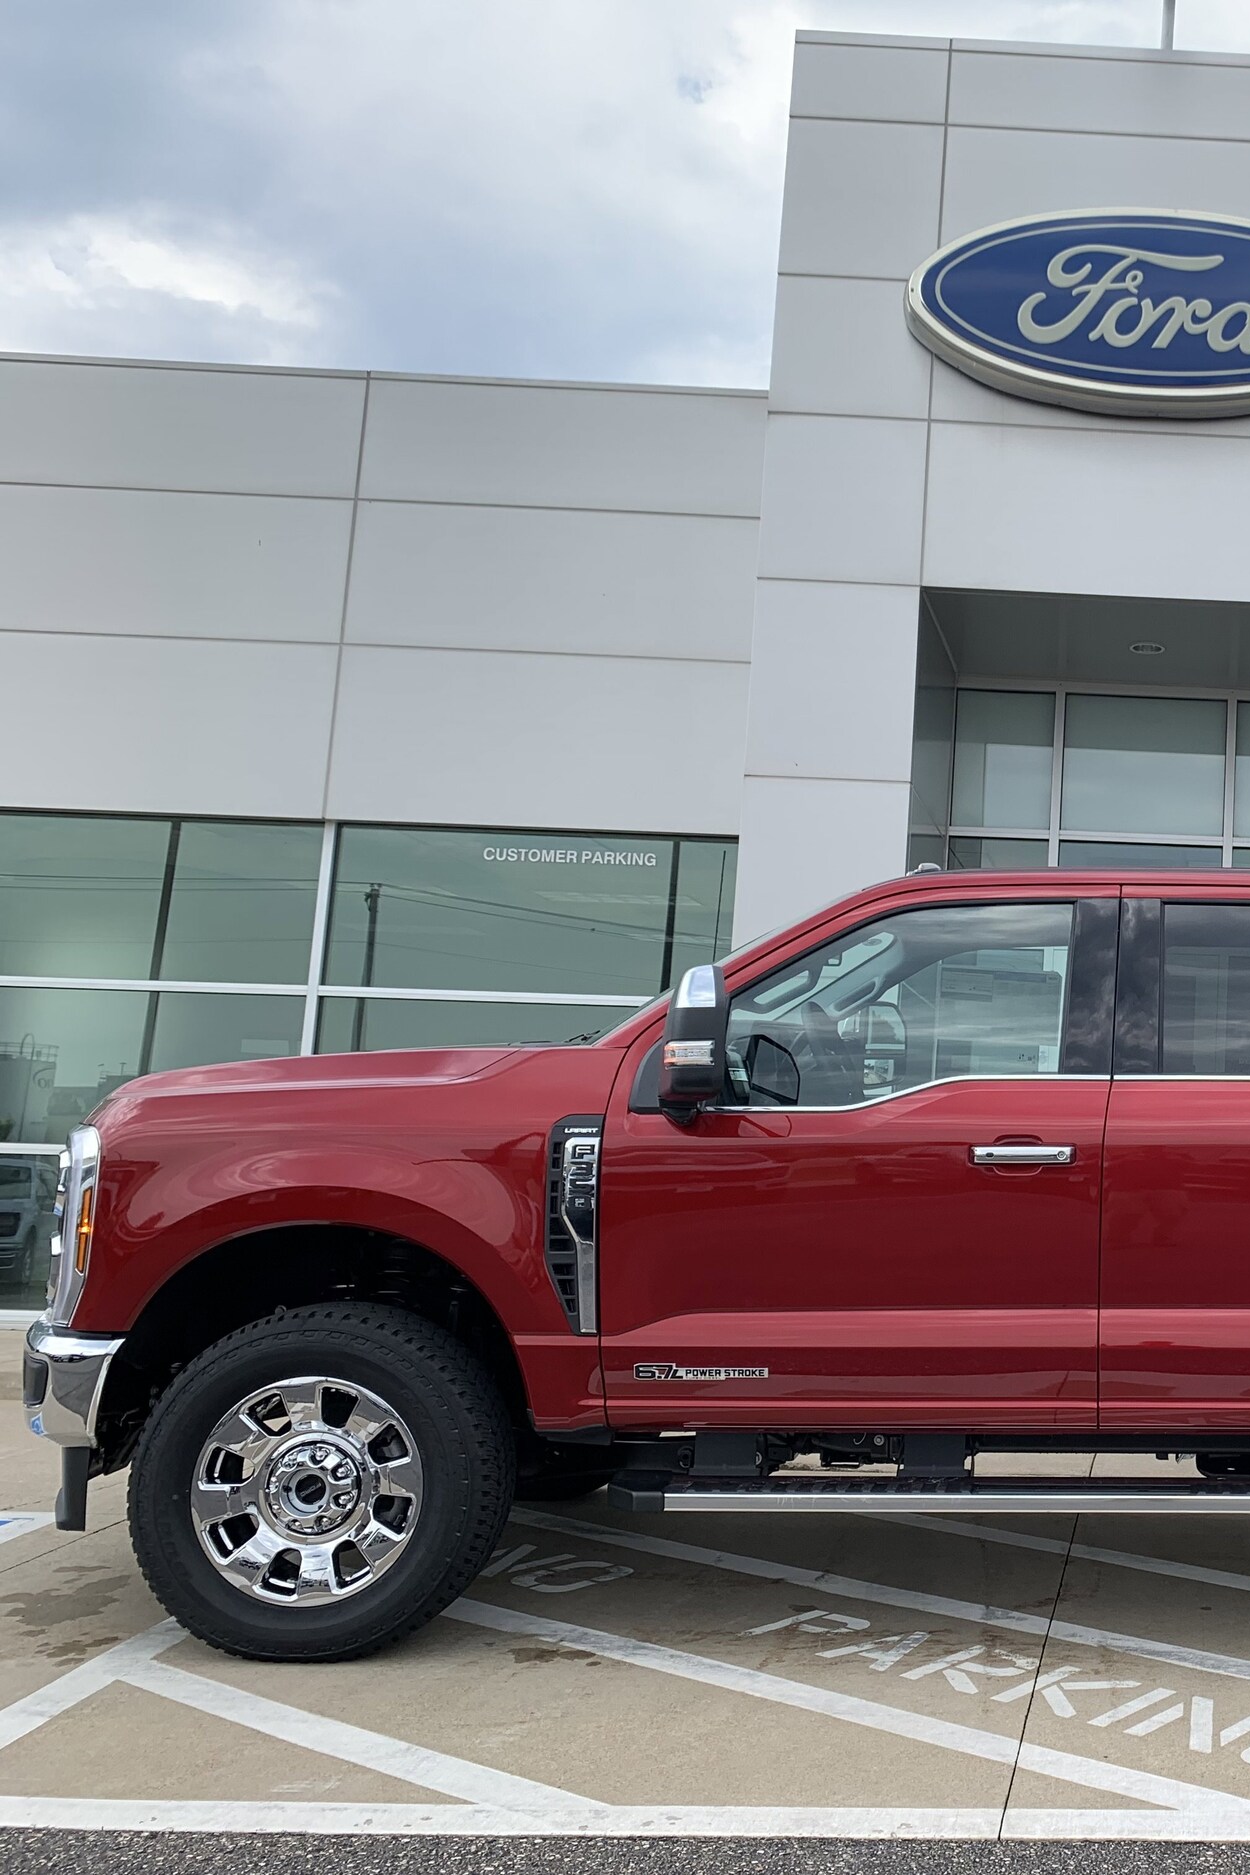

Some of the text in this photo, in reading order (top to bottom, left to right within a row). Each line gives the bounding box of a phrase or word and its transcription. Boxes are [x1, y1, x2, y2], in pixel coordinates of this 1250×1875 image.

[483, 847, 657, 867] CUSTOMER PARKING
[634, 1363, 684, 1380] 6.7L
[685, 1369, 721, 1377] POWER
[724, 1369, 765, 1377] STROKE
